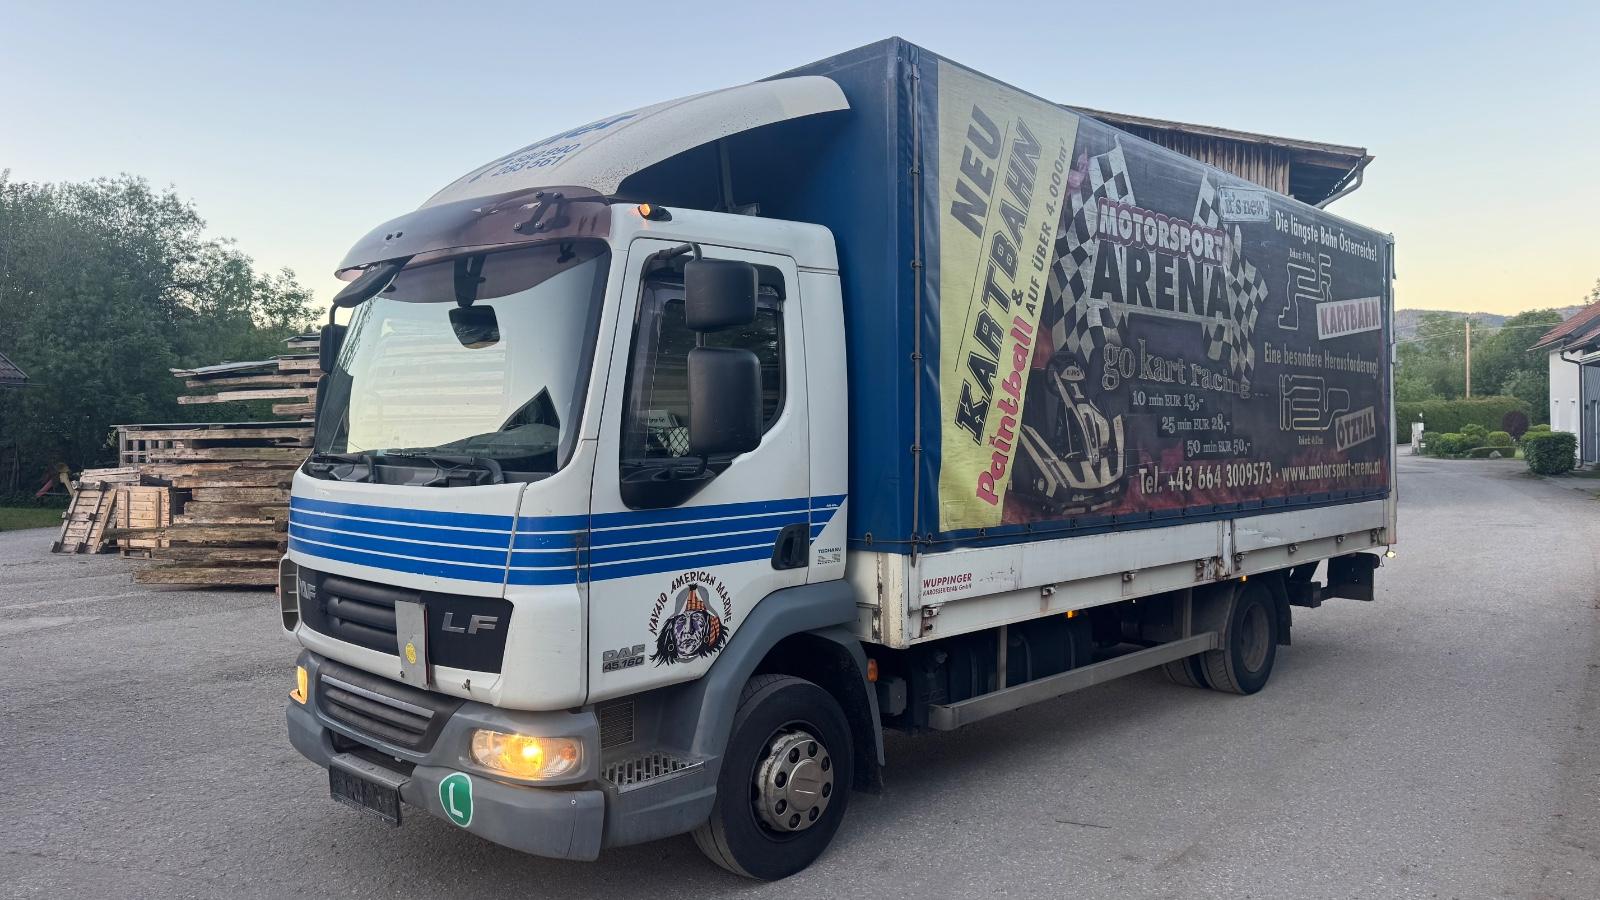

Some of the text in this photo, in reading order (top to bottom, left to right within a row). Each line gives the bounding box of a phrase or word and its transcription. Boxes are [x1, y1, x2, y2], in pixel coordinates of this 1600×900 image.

[951, 104, 1001, 239] NEU
[1025, 137, 1068, 317] AUF ÜBER 4.000m²
[1099, 204, 1224, 262] MOTORSPORT
[1275, 210, 1289, 233] Die
[1290, 213, 1319, 245] längste
[1320, 226, 1338, 249] Bahn
[1339, 228, 1377, 262] Österreichs!
[955, 117, 1042, 445] KARTBAHN
[1011, 288, 1024, 306] &
[1090, 240, 1232, 319] ARENA
[1320, 301, 1379, 335] KARTBAHN
[1102, 342, 1136, 391] go
[1137, 338, 1187, 385] kart
[1264, 341, 1281, 363] Eine
[1284, 344, 1322, 368] besondere
[976, 315, 1034, 506] Paintball
[1132, 390, 1204, 412] 10 min EUR 13,-
[1161, 413, 1231, 434] 25 min EUR 28,-
[1337, 412, 1375, 449] ÖTZTAL
[1187, 439, 1251, 458] 50 min EUR 50,-
[1139, 466, 1163, 494] Tel.
[1168, 466, 1193, 492] +43
[1197, 464, 1222, 490] 664
[1226, 461, 1272, 488] 3009573
[298, 577, 317, 600] AF
[923, 572, 972, 589] WUPPINGER
[648, 571, 732, 637] NAVAJO AMERICAN MARINE
[441, 611, 499, 635] LF
[603, 643, 646, 661] DAF
[448, 782, 464, 818] L
